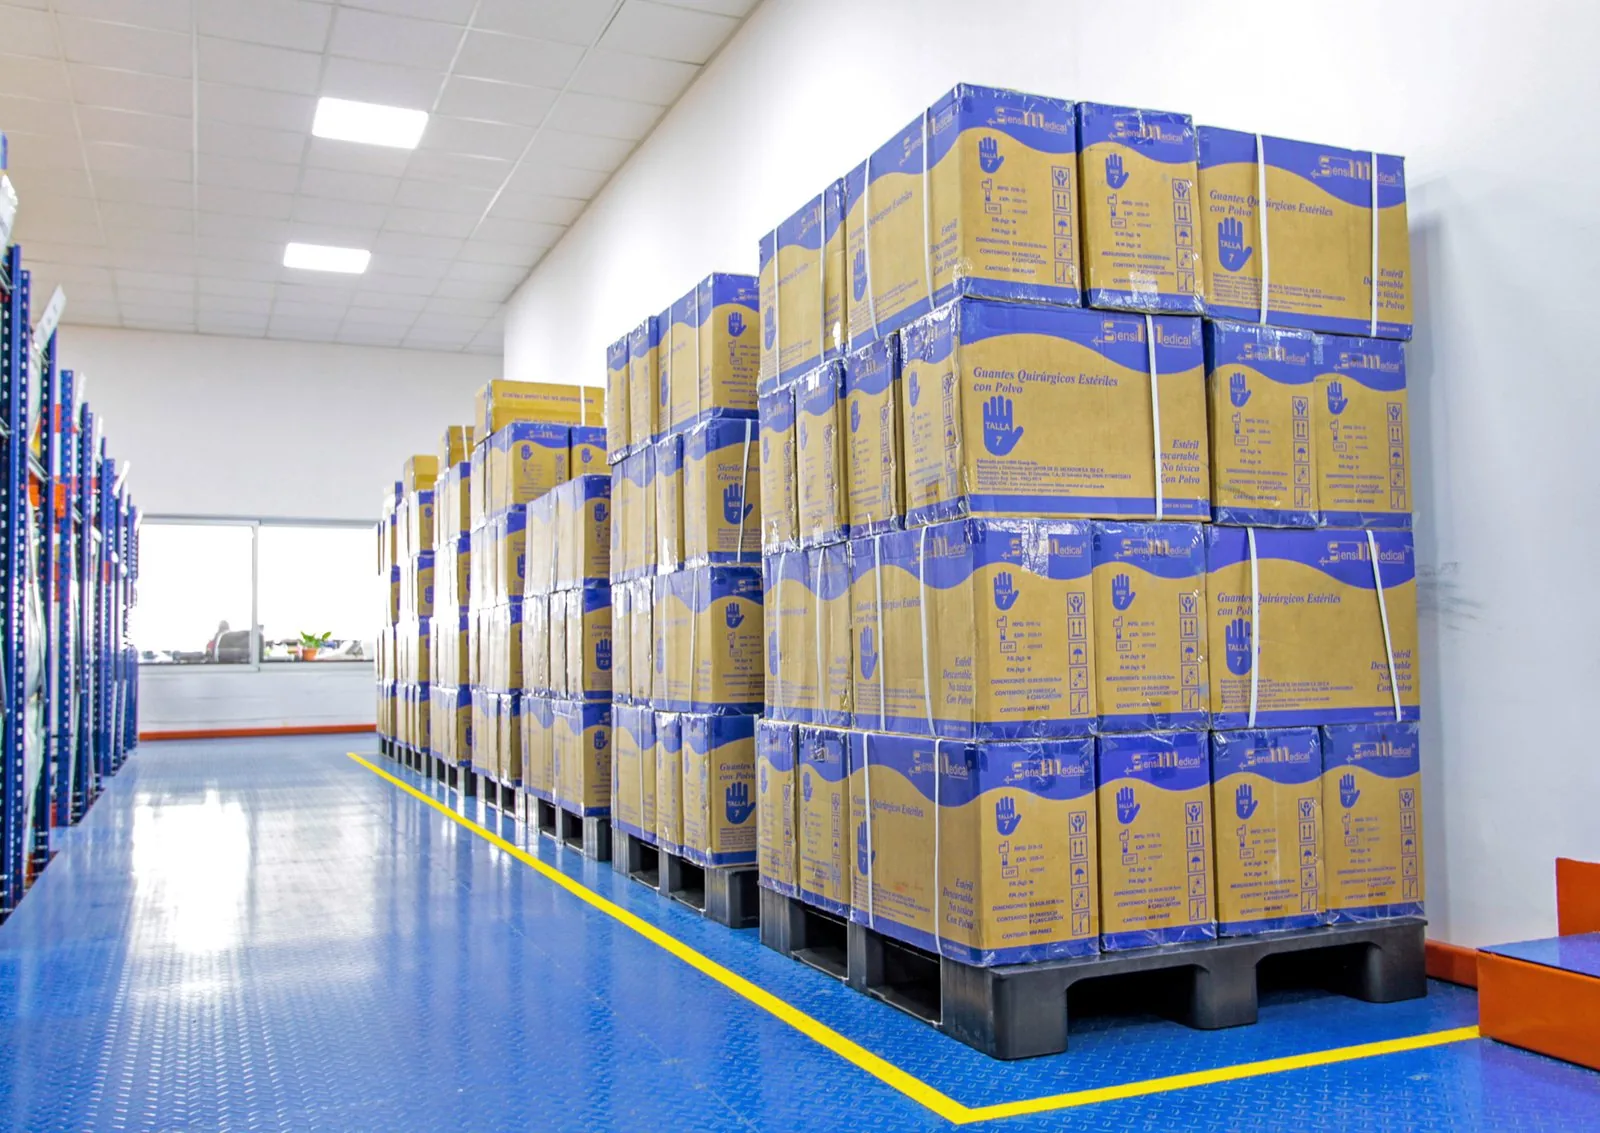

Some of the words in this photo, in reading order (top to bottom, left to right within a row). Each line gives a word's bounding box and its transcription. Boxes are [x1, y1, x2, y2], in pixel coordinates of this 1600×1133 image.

[1210, 189, 1244, 204] Guantes
[1210, 205, 1225, 213] con
[1228, 205, 1252, 216] Polvo
[1220, 240, 1241, 249] TALLA
[1229, 254, 1234, 263] 7
[973, 367, 1014, 379] Guantes
[1018, 370, 1075, 384] Quirúrgicos
[1078, 374, 1118, 387] Estériles
[995, 383, 1023, 393] Polvo
[985, 422, 1010, 431] TALLA
[996, 436, 1002, 446] 7
[1172, 440, 1199, 449] Estéril
[1160, 452, 1199, 461] escartable
[1162, 462, 1173, 471] No
[1176, 463, 1199, 472] tóxico
[1179, 474, 1200, 484] Polvo
[1307, 593, 1341, 603] Estériles
[1392, 650, 1411, 658] stéril
[1237, 657, 1242, 666] 7
[1396, 682, 1412, 692] olvo
[1004, 821, 1009, 830] 7
